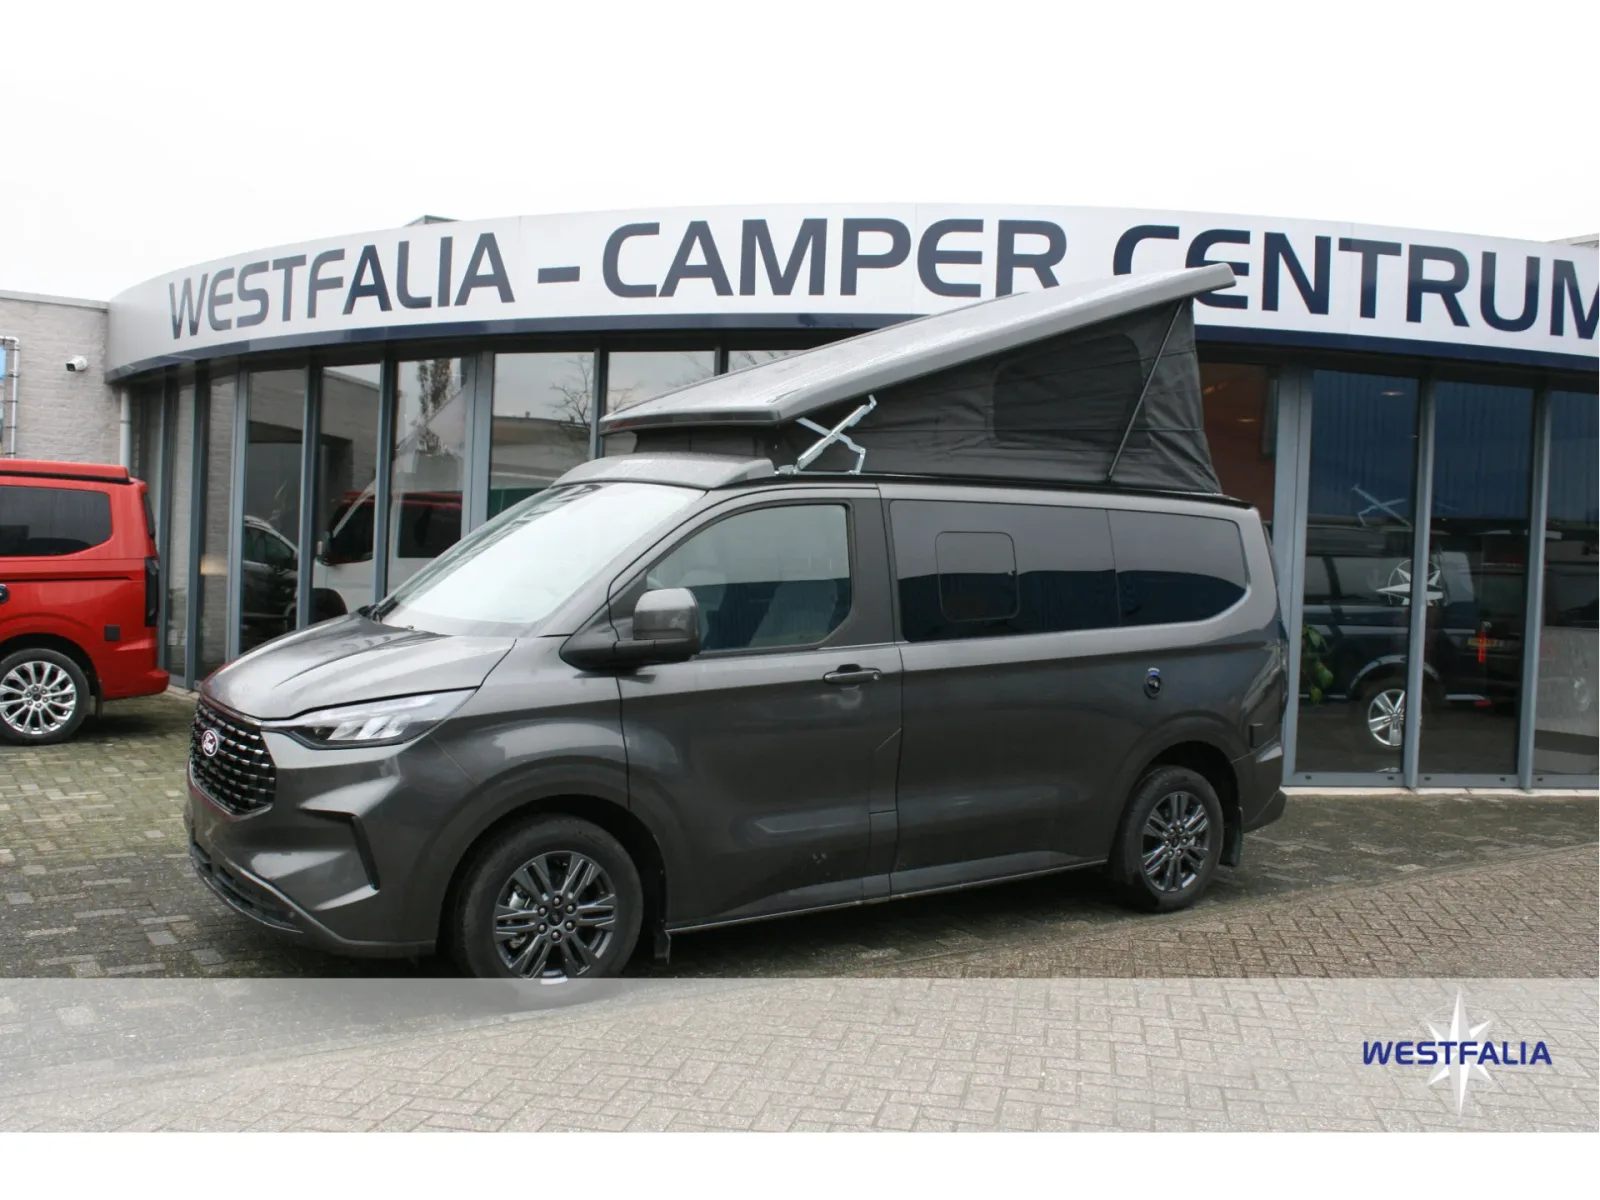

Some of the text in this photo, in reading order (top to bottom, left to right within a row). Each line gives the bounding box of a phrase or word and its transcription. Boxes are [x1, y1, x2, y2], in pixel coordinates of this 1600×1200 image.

[168, 232, 516, 340] WESTFALIA
[602, 217, 1068, 298] CAMPER
[1112, 224, 1599, 340] CENTRUM
